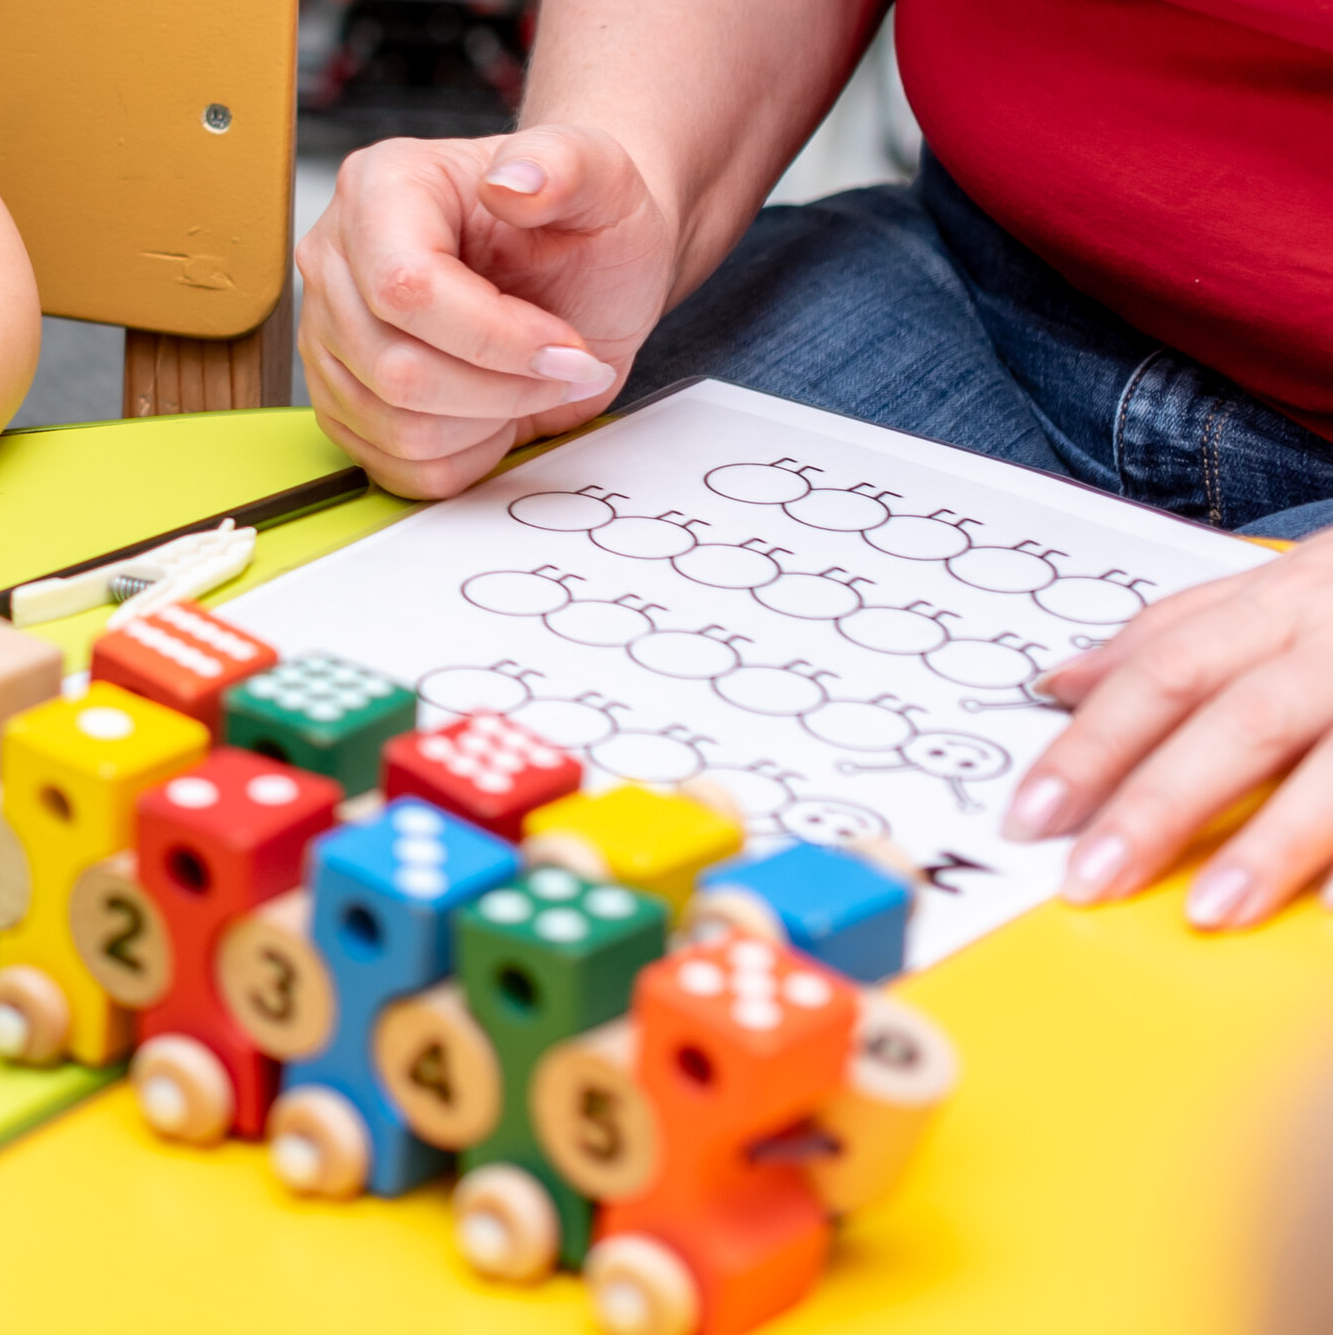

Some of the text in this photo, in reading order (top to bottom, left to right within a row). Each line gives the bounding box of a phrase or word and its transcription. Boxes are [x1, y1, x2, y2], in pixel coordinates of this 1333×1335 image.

[921, 851, 1000, 895] 2
[100, 891, 145, 974] 2
[249, 946, 299, 1025] 3
[407, 1038, 454, 1108] 4
[577, 1086, 624, 1165] 5
